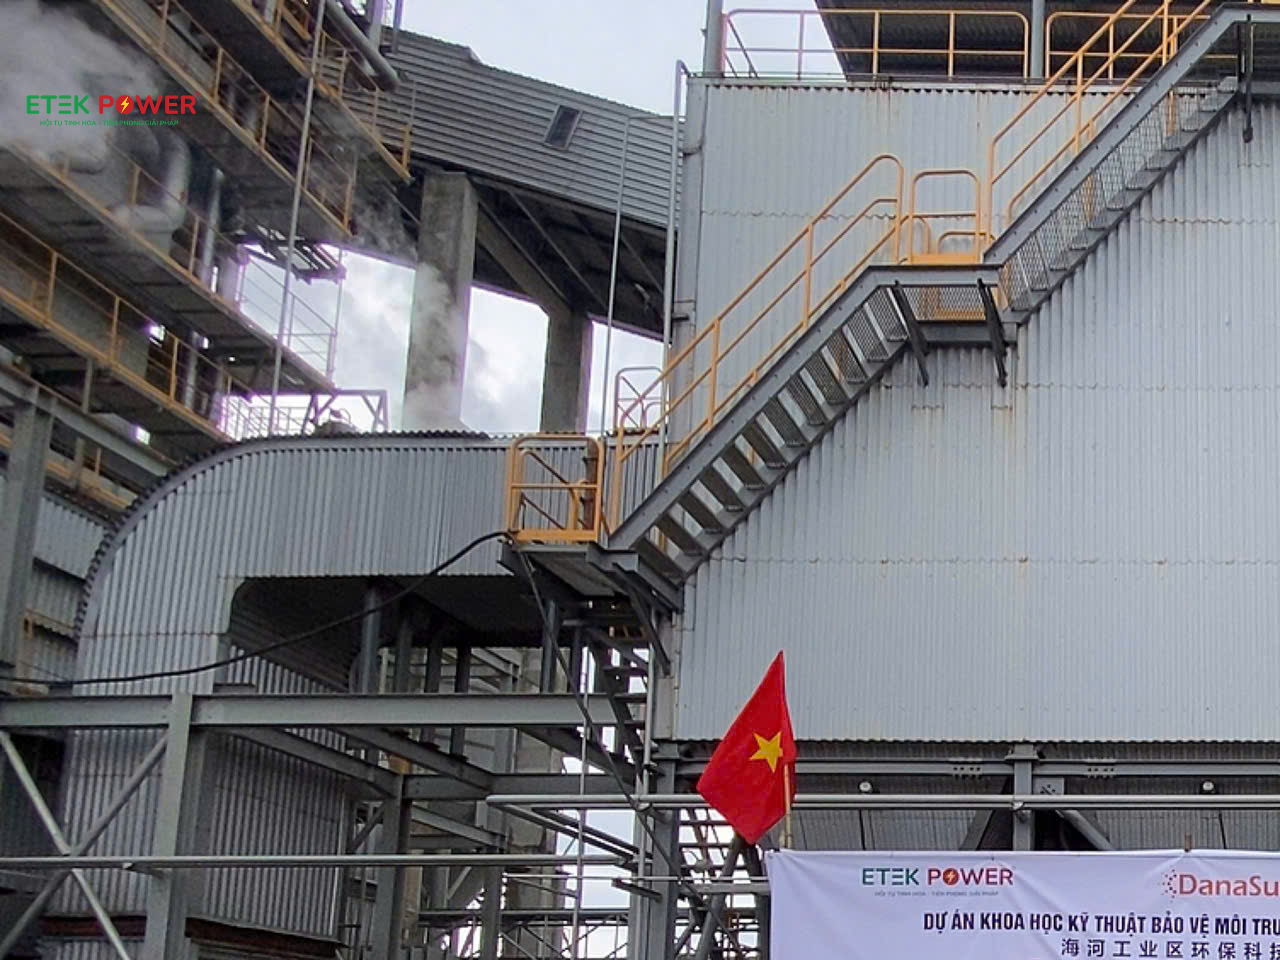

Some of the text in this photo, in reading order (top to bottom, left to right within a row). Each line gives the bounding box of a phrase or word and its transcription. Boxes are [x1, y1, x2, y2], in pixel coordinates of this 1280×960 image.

[862, 867, 1014, 886] ETEK POWER
[923, 911, 949, 933] DỰ
[951, 908, 975, 931] ÁN
[980, 912, 1025, 931] KHOA
[1029, 913, 1063, 935] HỌC
[1068, 909, 1089, 932] KỸ
[1095, 910, 1147, 937] THUẬT
[1151, 910, 1184, 934] BẢO
[1189, 911, 1210, 938] VỆ
[1214, 911, 1247, 936] MÔI
